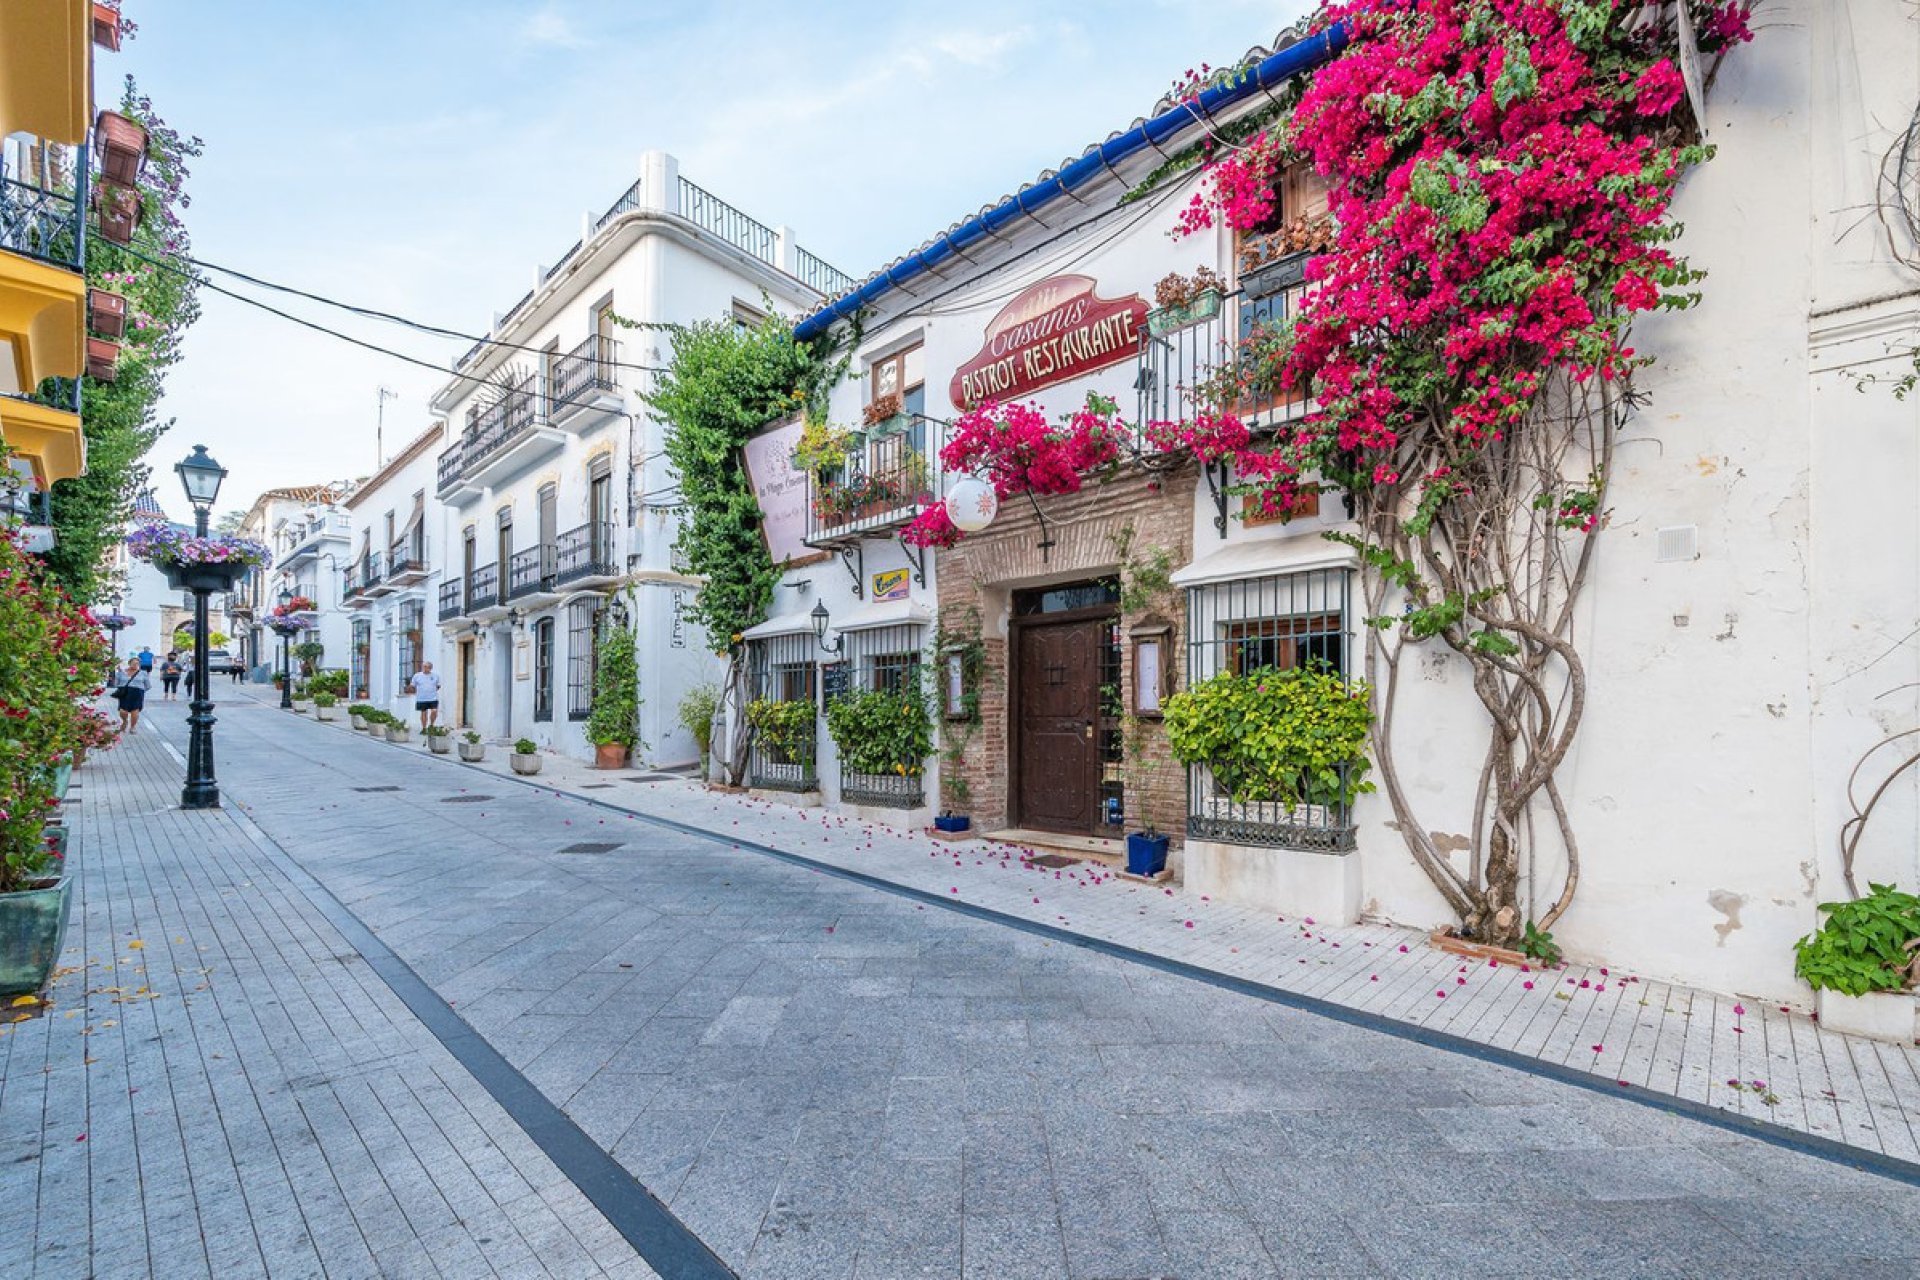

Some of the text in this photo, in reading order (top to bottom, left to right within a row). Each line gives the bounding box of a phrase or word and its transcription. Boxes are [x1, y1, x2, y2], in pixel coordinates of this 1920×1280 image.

[961, 307, 1138, 403] BISTROT RESTAURANTE
[991, 299, 1090, 357] Casanis
